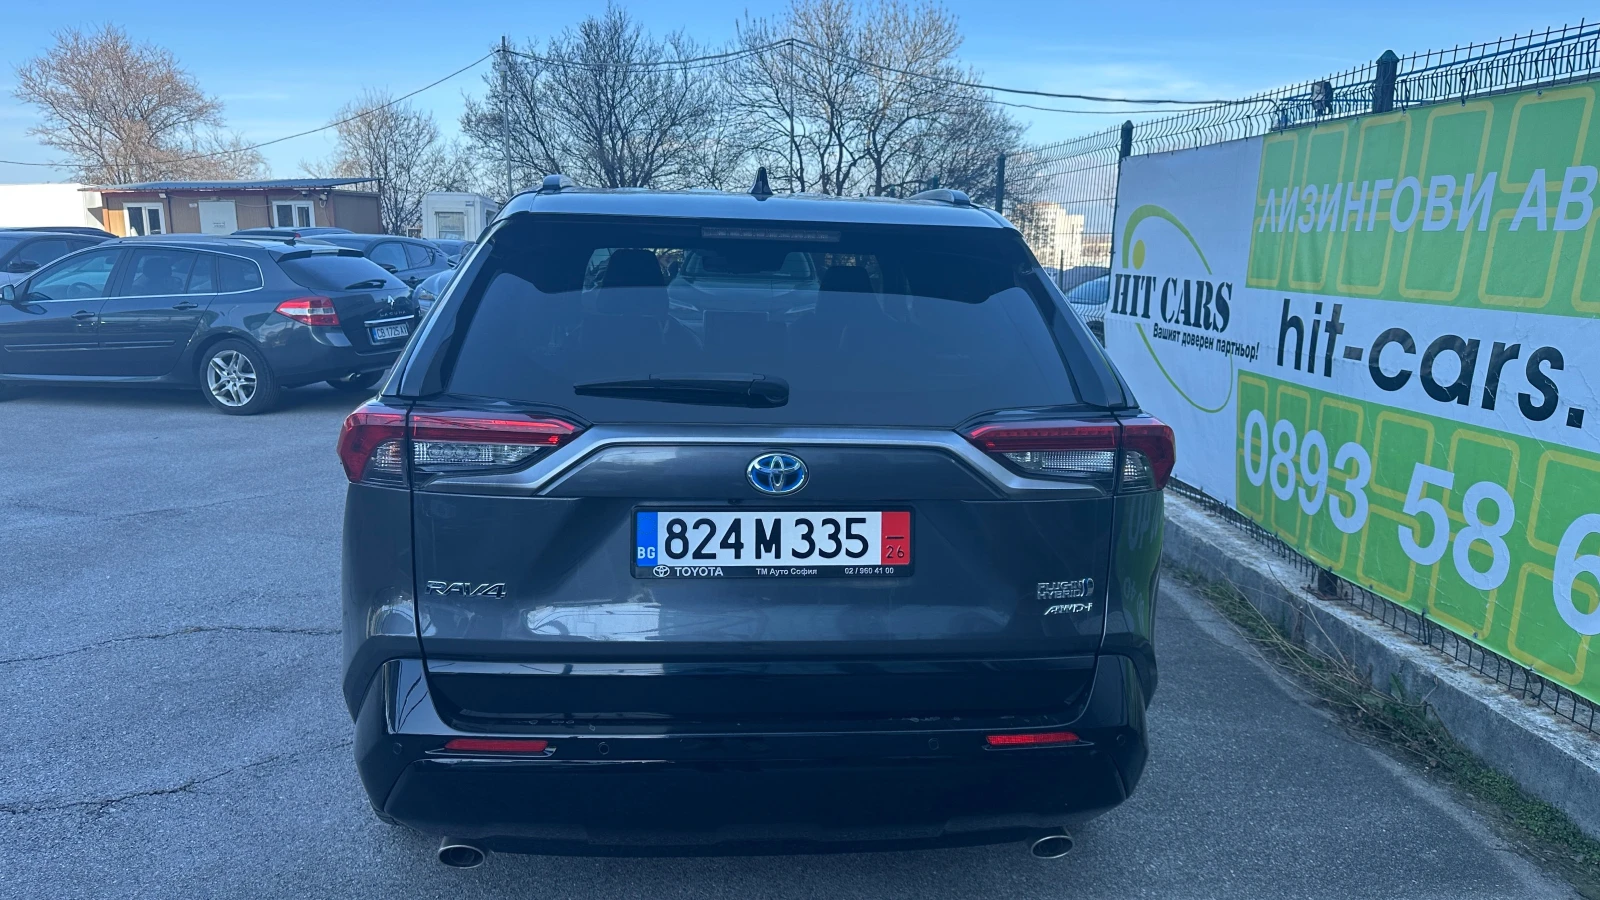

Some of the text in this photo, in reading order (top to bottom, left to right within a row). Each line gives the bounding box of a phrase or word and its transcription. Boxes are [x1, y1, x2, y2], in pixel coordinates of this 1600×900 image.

[1258, 171, 1498, 234] ЛИЗИНГОВИ
[1110, 273, 1233, 333] HIT CARS
[1153, 323, 1260, 363] Вашият доверен партньор!
[1277, 298, 1585, 429] hit-cars.
[1244, 409, 1372, 534] 0893
[1398, 462, 1516, 591] 58
[664, 517, 869, 560] 824 M 335
[637, 546, 656, 559] BG
[886, 545, 905, 559] 26
[675, 567, 724, 577] TOYOTA
[769, 568, 789, 577] Ауто
[790, 568, 818, 577] София
[844, 567, 854, 575] 02
[874, 567, 883, 575] 41
[885, 567, 895, 575] 00
[425, 580, 507, 600] RAV4
[1037, 580, 1083, 591] PLUG-IN
[1037, 589, 1082, 600] HYBRID
